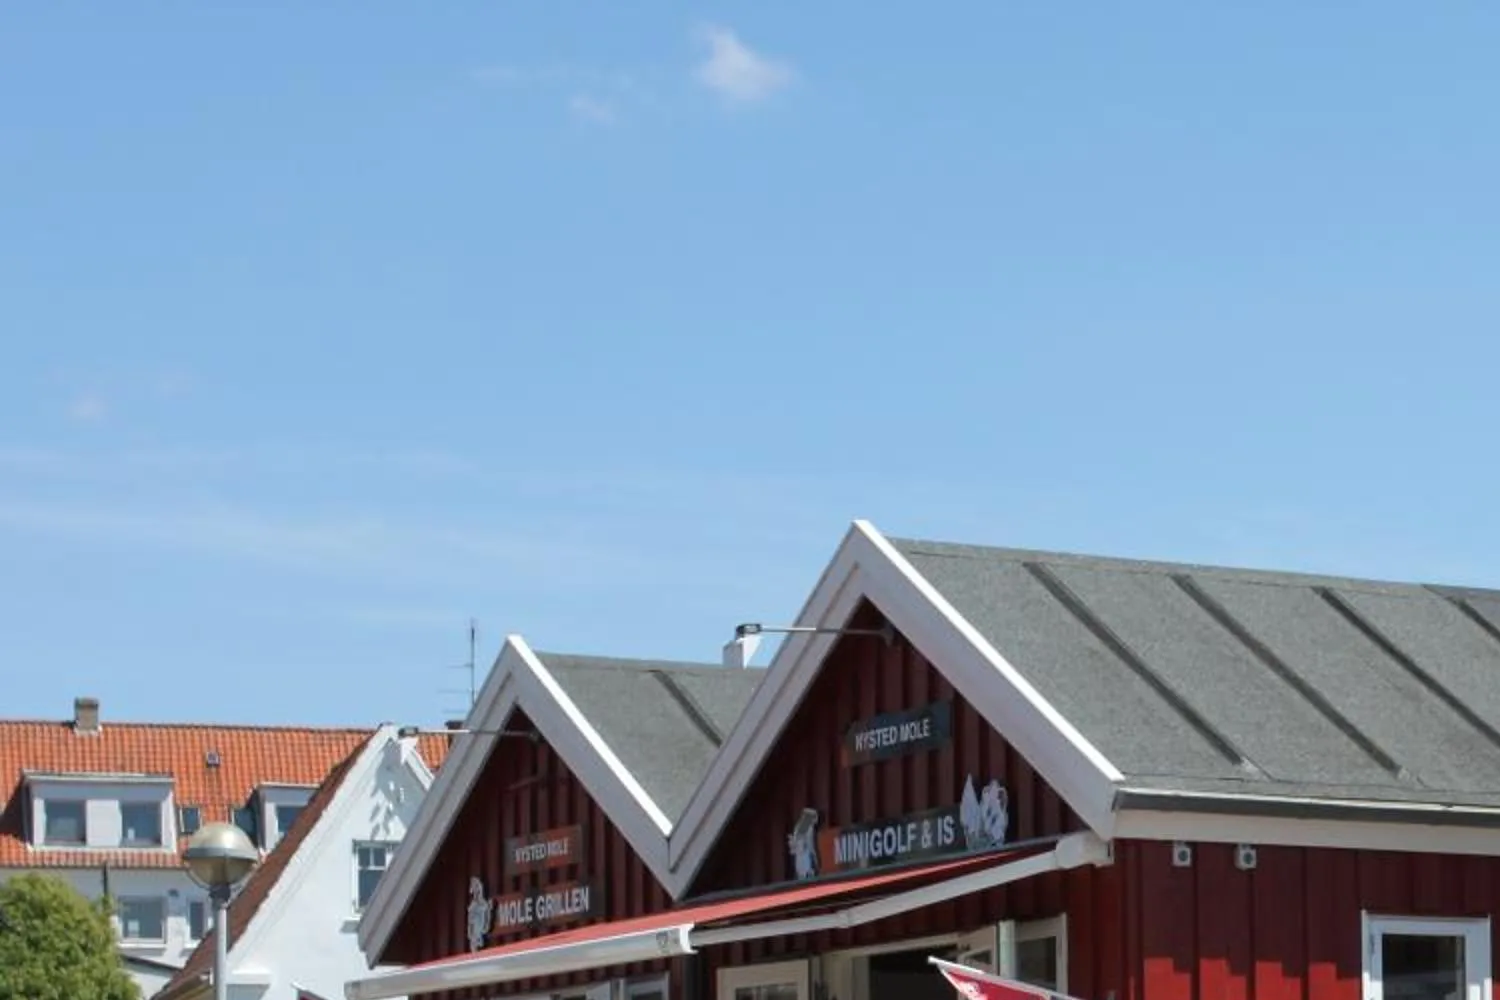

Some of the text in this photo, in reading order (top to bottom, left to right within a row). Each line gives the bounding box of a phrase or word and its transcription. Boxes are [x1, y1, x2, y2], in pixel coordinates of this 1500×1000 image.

[855, 717, 932, 751] NYSTED MOLE
[833, 815, 955, 865] MINIGOLF & IS
[498, 886, 590, 926] MOLE GRILLEN
